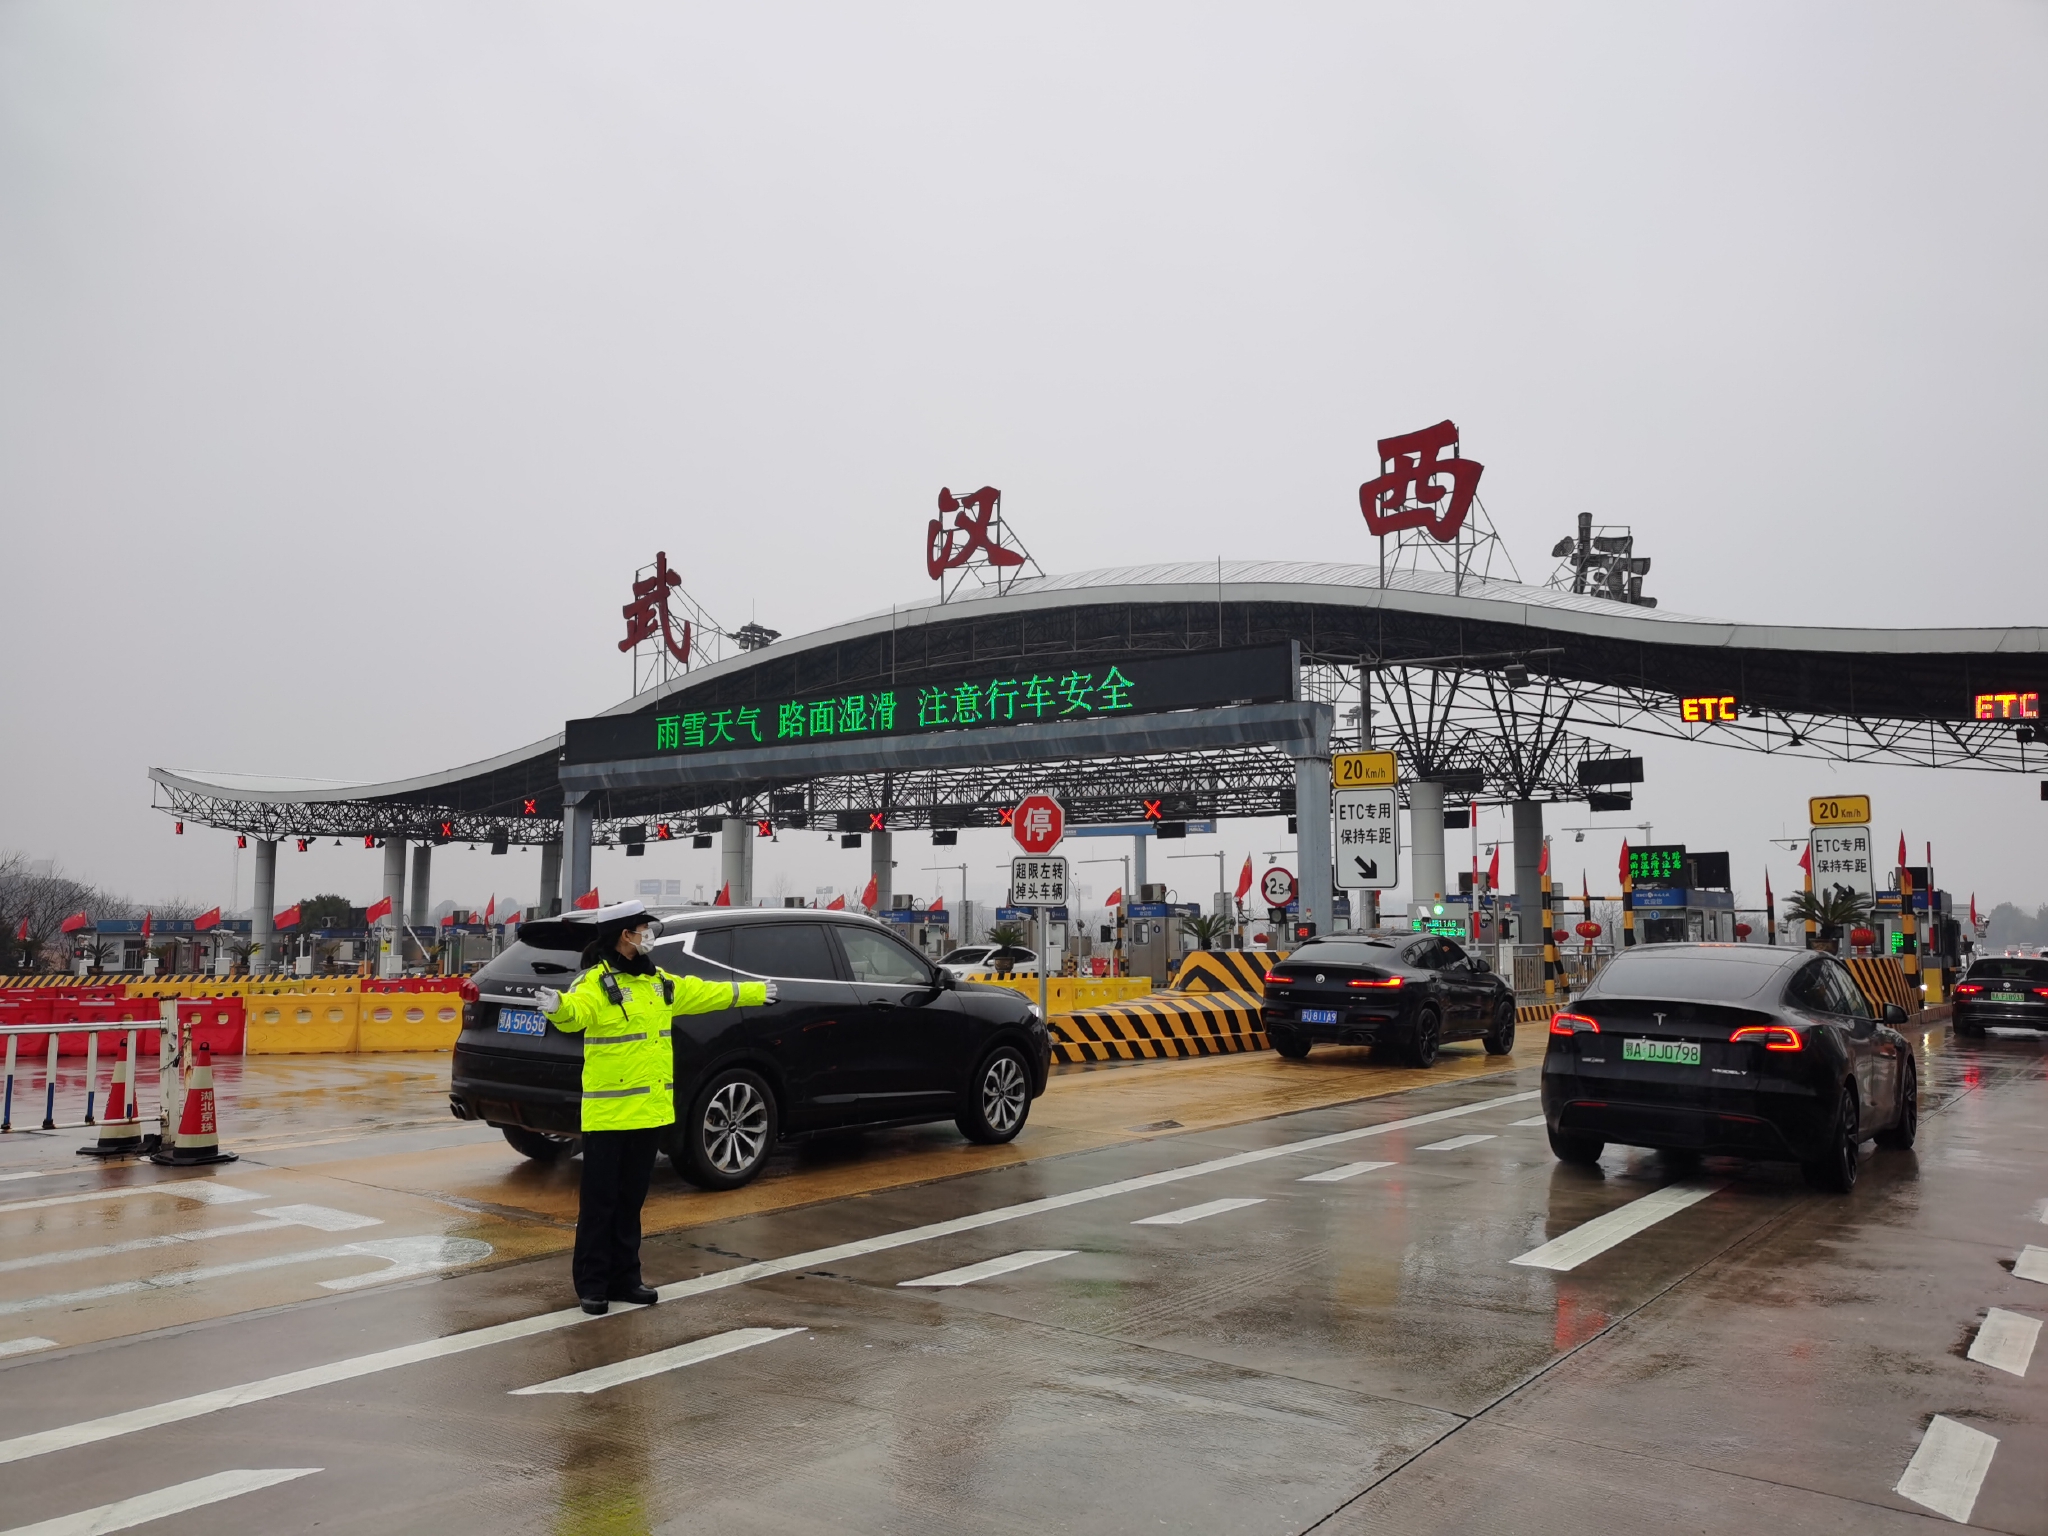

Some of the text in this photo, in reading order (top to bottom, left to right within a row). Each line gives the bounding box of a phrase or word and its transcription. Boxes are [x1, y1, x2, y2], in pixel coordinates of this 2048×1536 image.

[618, 419, 1484, 664] 武汉西
[655, 665, 1135, 750] 雨雪天气 路面湿滑 注意行车安全
[1682, 697, 1735, 721] ETC
[1975, 692, 2038, 719] ETC
[1343, 759, 1386, 780] 20 Km/h
[1339, 803, 1391, 820] ETC专用
[1819, 802, 1861, 819] 20 Km/h
[1023, 807, 1052, 842] 停
[1340, 827, 1392, 845] 保持车距
[1815, 838, 1866, 853] ETC专用
[1015, 862, 1064, 880] 超限左转
[1817, 858, 1867, 873] 保持车距
[1015, 882, 1063, 900] 掉头车辆
[504, 986, 535, 994] WEY
[200, 1090, 214, 1132] 湖北京珠
